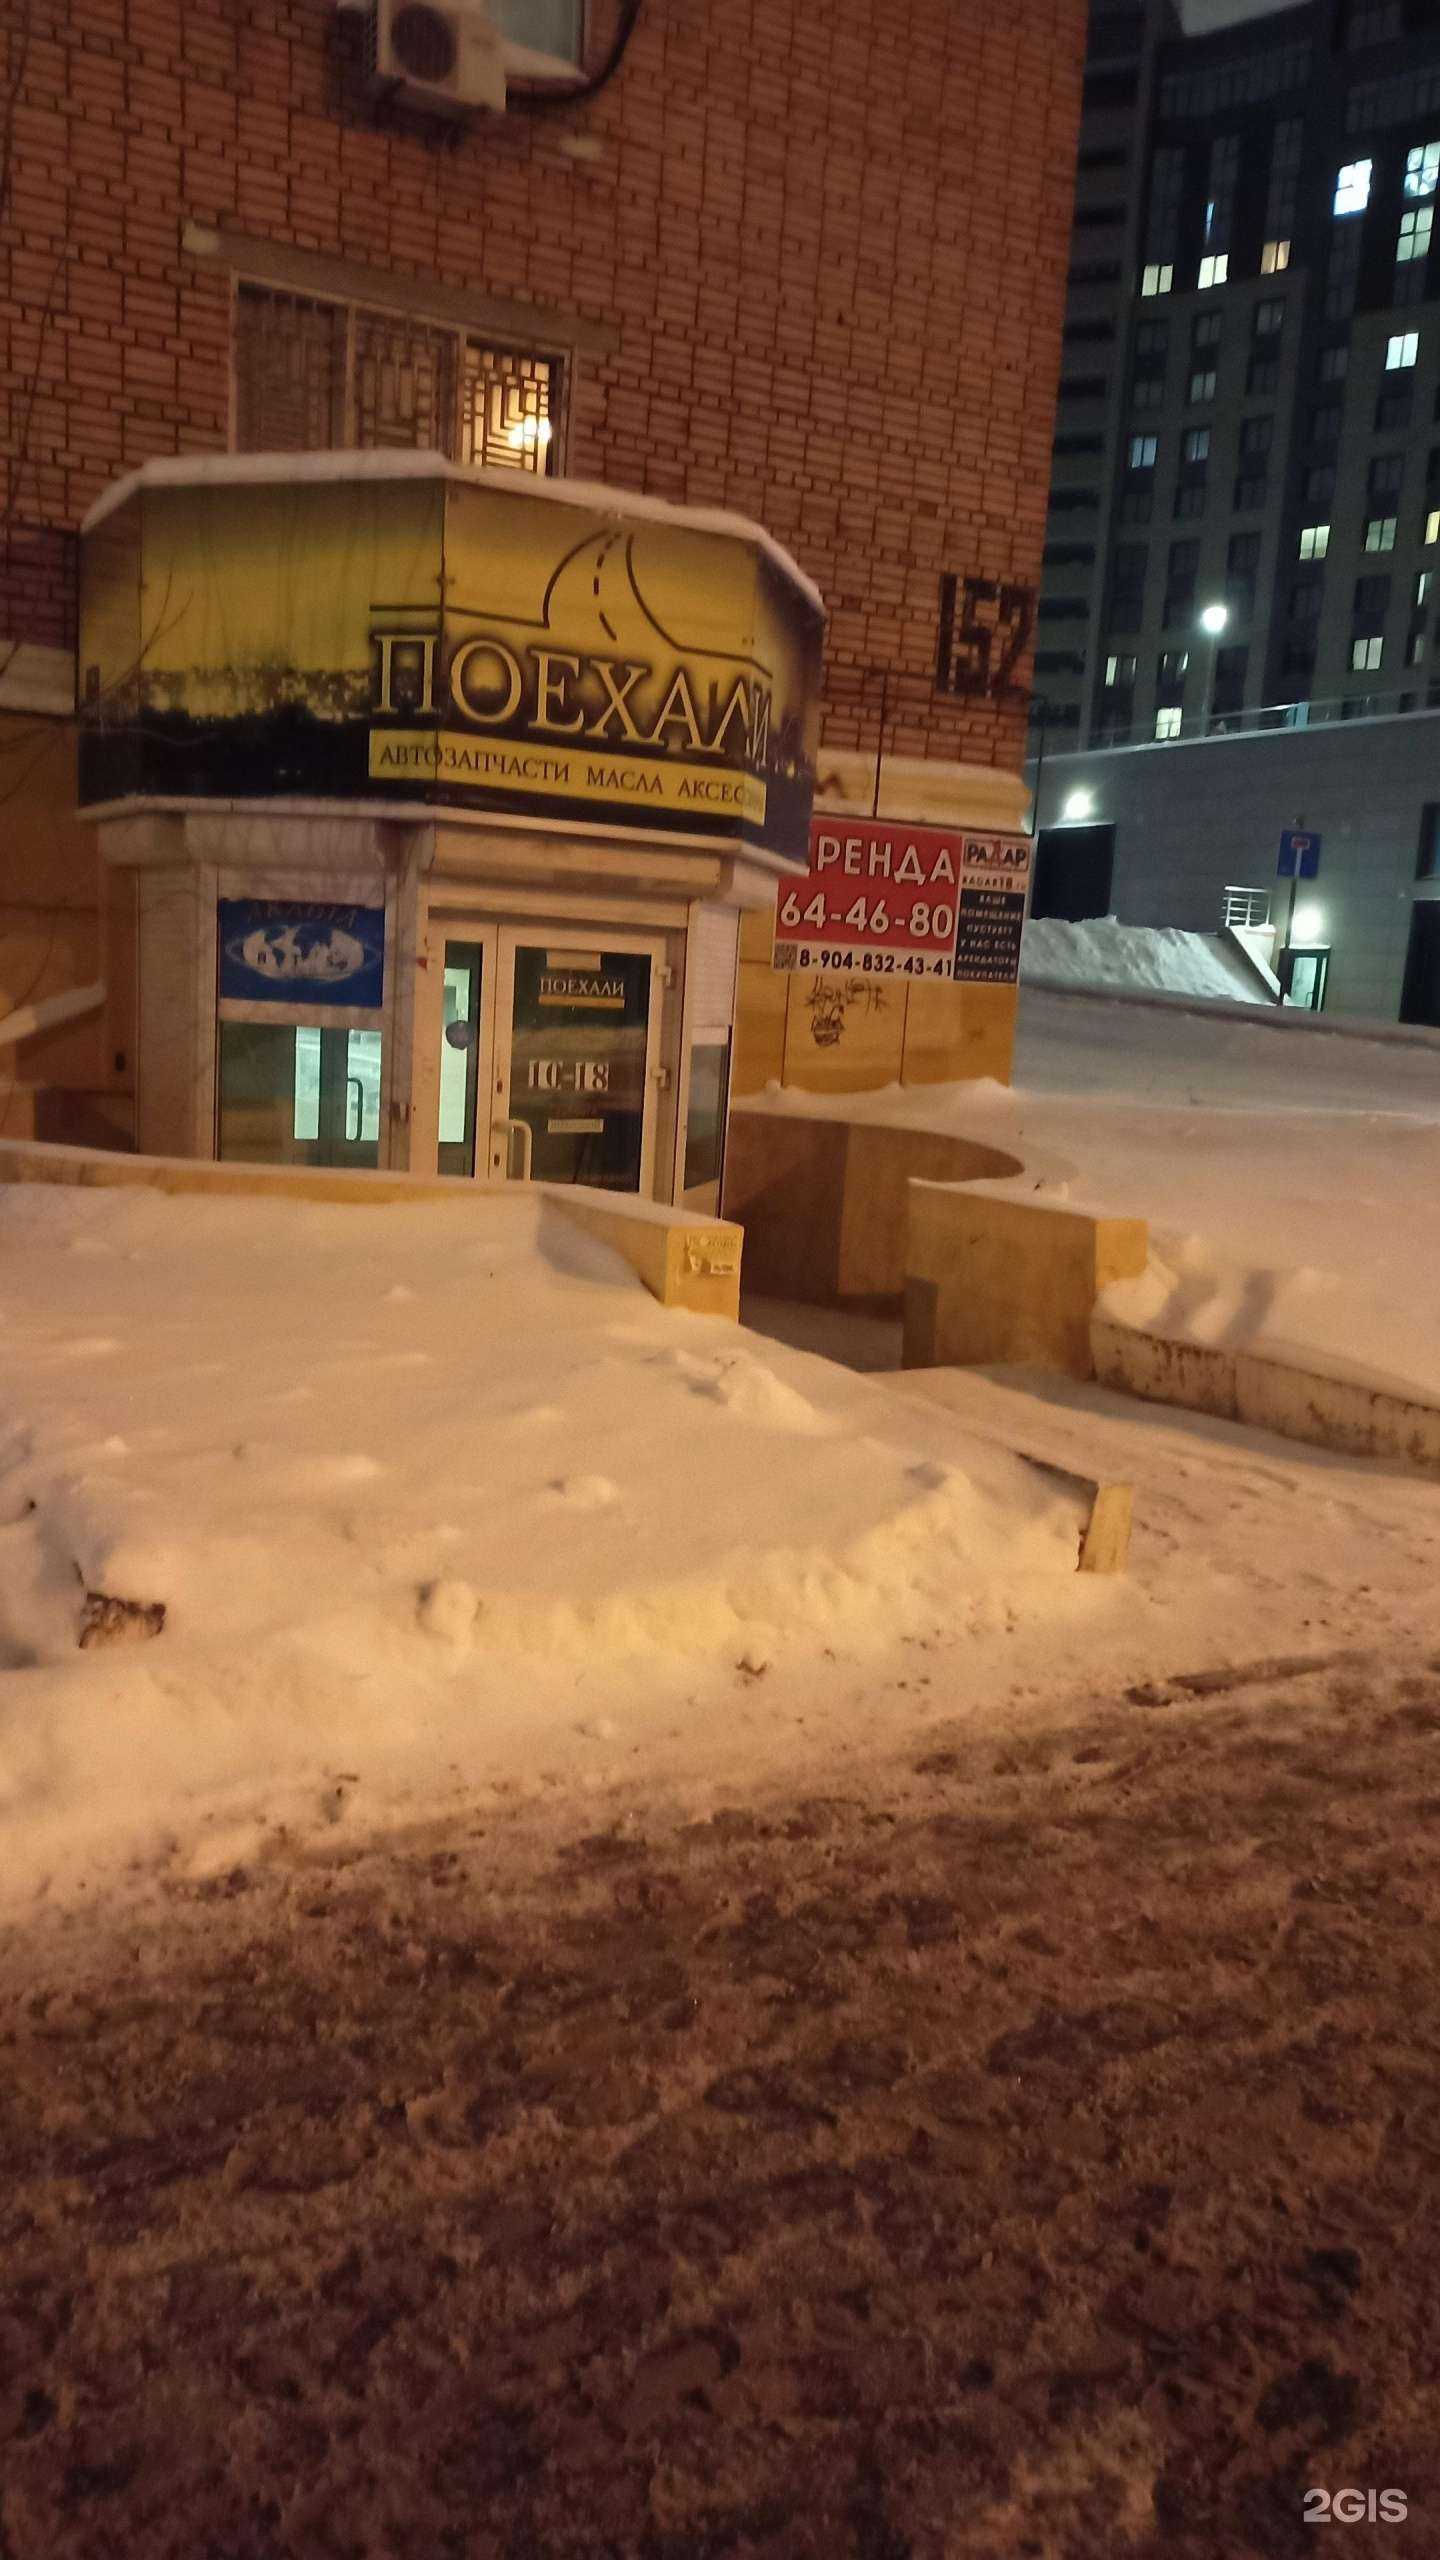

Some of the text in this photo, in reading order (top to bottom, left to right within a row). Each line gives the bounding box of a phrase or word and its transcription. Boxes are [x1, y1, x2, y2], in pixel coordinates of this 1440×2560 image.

[373, 634, 769, 768] ПОЕХАЛИ
[379, 745, 570, 783] АВТОЗАПЧАСТИ
[586, 765, 664, 795] МАСЛА
[817, 835, 956, 885] РЕНДА
[965, 840, 1027, 867] РАДАР
[780, 890, 953, 939] 64-46-80
[540, 976, 625, 997] ПОЕХАЛИ
[799, 949, 952, 977] 8-904-832-43-41
